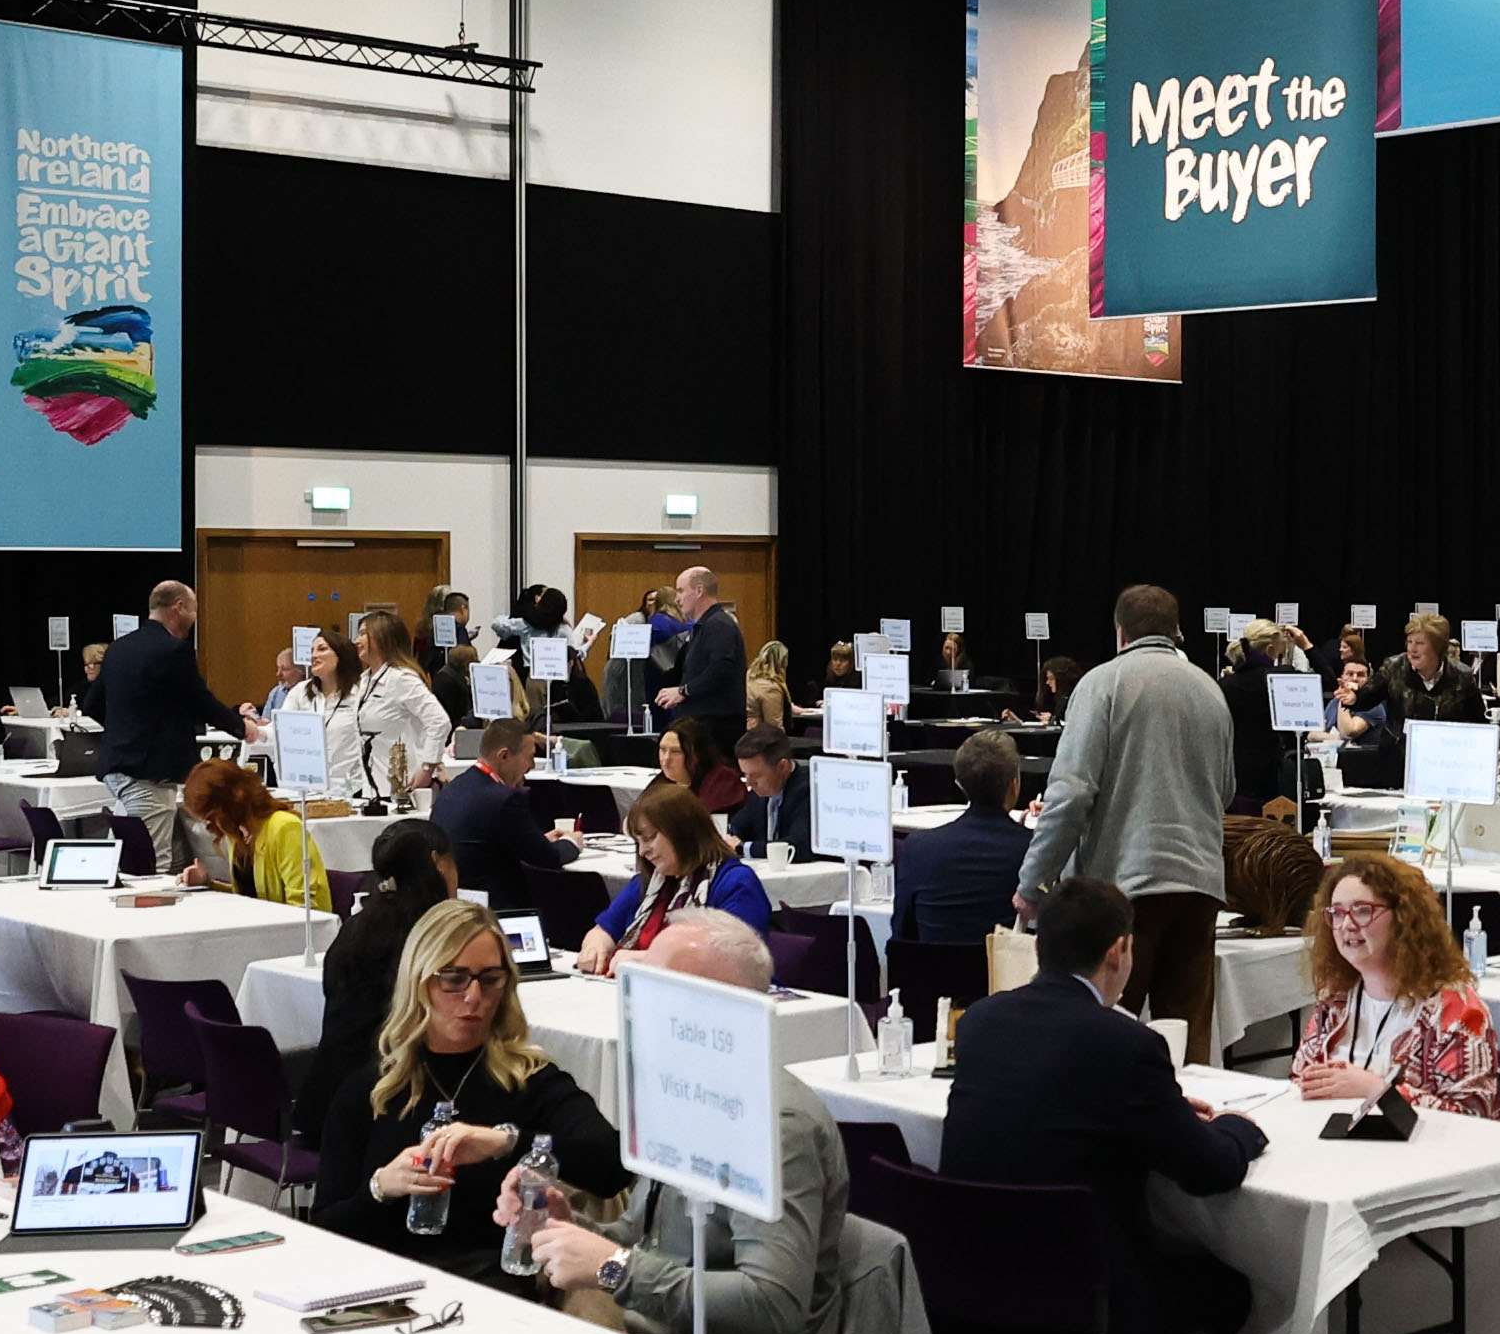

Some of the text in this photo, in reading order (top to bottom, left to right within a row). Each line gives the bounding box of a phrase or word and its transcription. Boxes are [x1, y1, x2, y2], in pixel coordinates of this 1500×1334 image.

[1131, 58, 1347, 152] Meet the
[17, 129, 150, 164] Northern
[18, 154, 150, 194] Ireland
[1164, 135, 1328, 223] Buyer
[16, 194, 150, 230] Embrace
[15, 256, 152, 312] Spirit
[669, 1018, 734, 1054] Table 159
[660, 1074, 743, 1121] Visit Armagh
